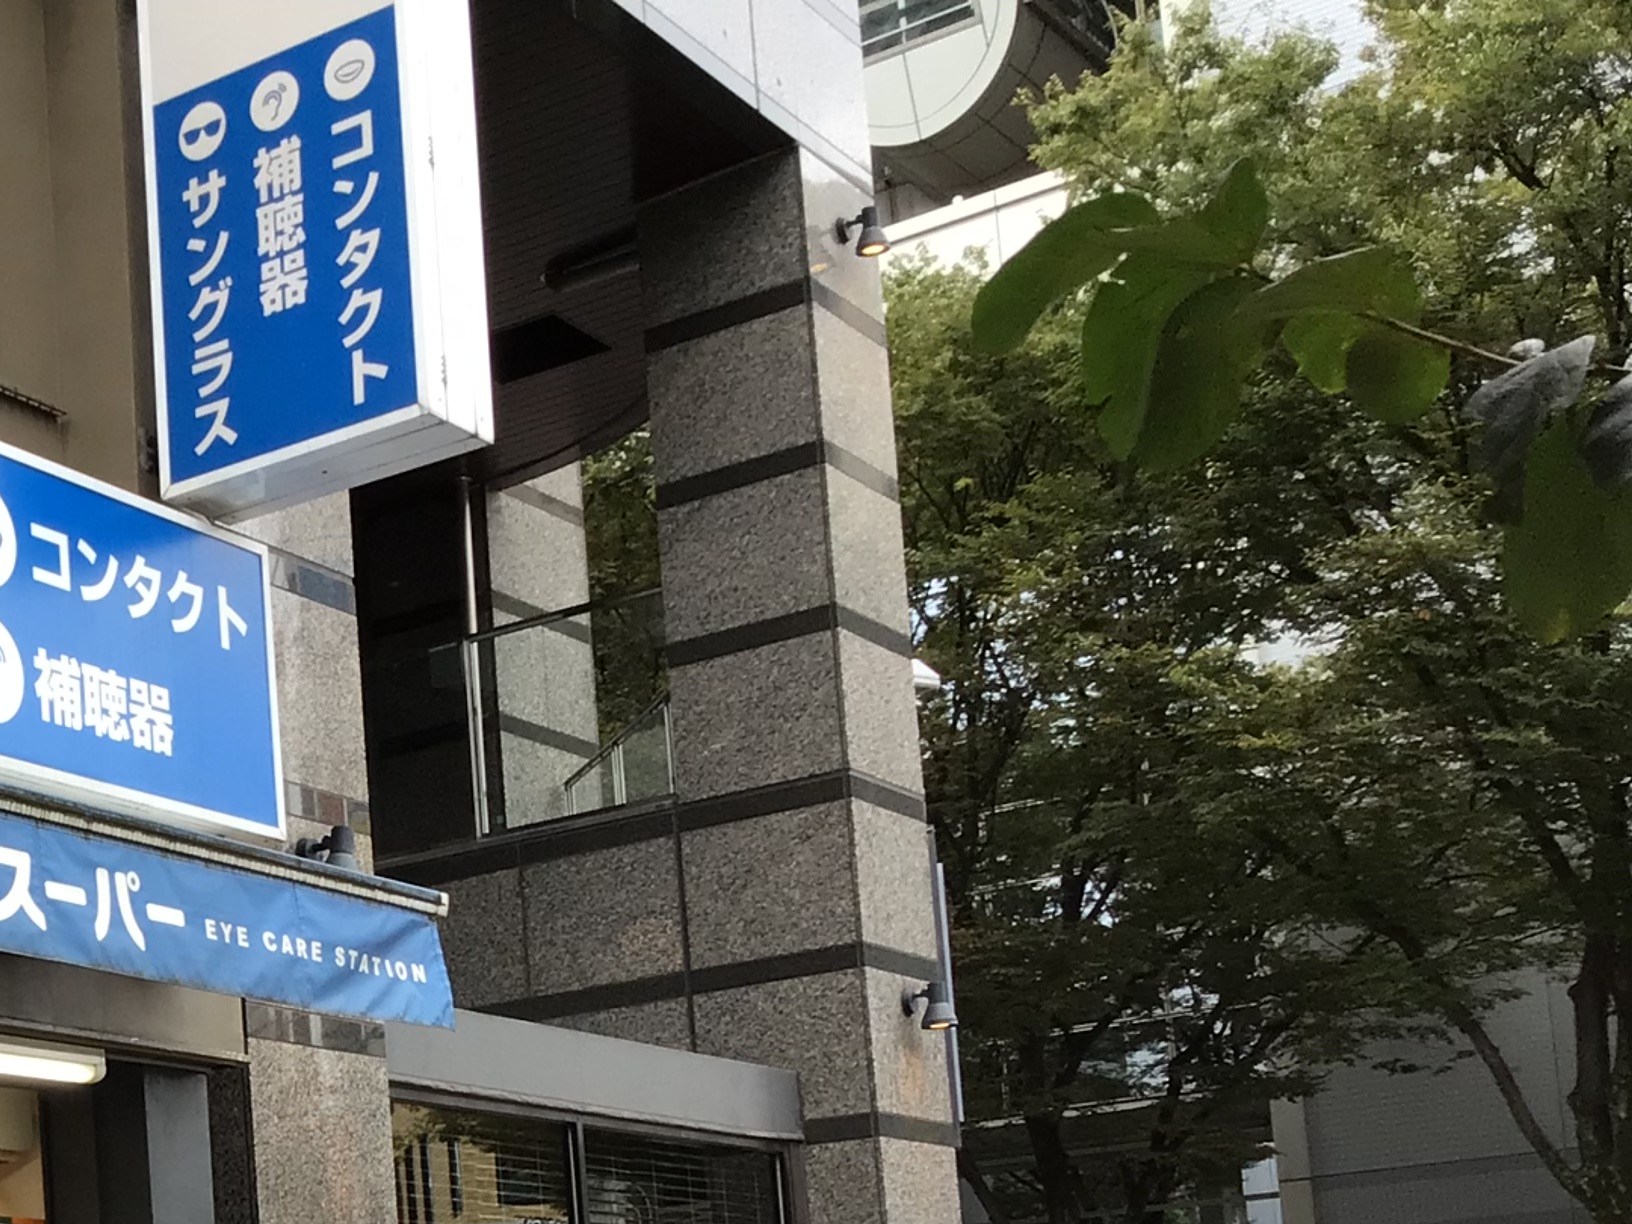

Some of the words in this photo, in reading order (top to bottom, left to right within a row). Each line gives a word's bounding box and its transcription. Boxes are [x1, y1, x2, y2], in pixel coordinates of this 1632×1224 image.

[252, 134, 309, 317] 補聴器
[330, 109, 389, 406] コンタクト
[182, 169, 238, 457] サングラス
[29, 522, 248, 651] コンタクト
[33, 646, 174, 757] 補聴器
[205, 918, 250, 948] EYE
[262, 932, 323, 963] CARE
[334, 946, 428, 984] STATION
